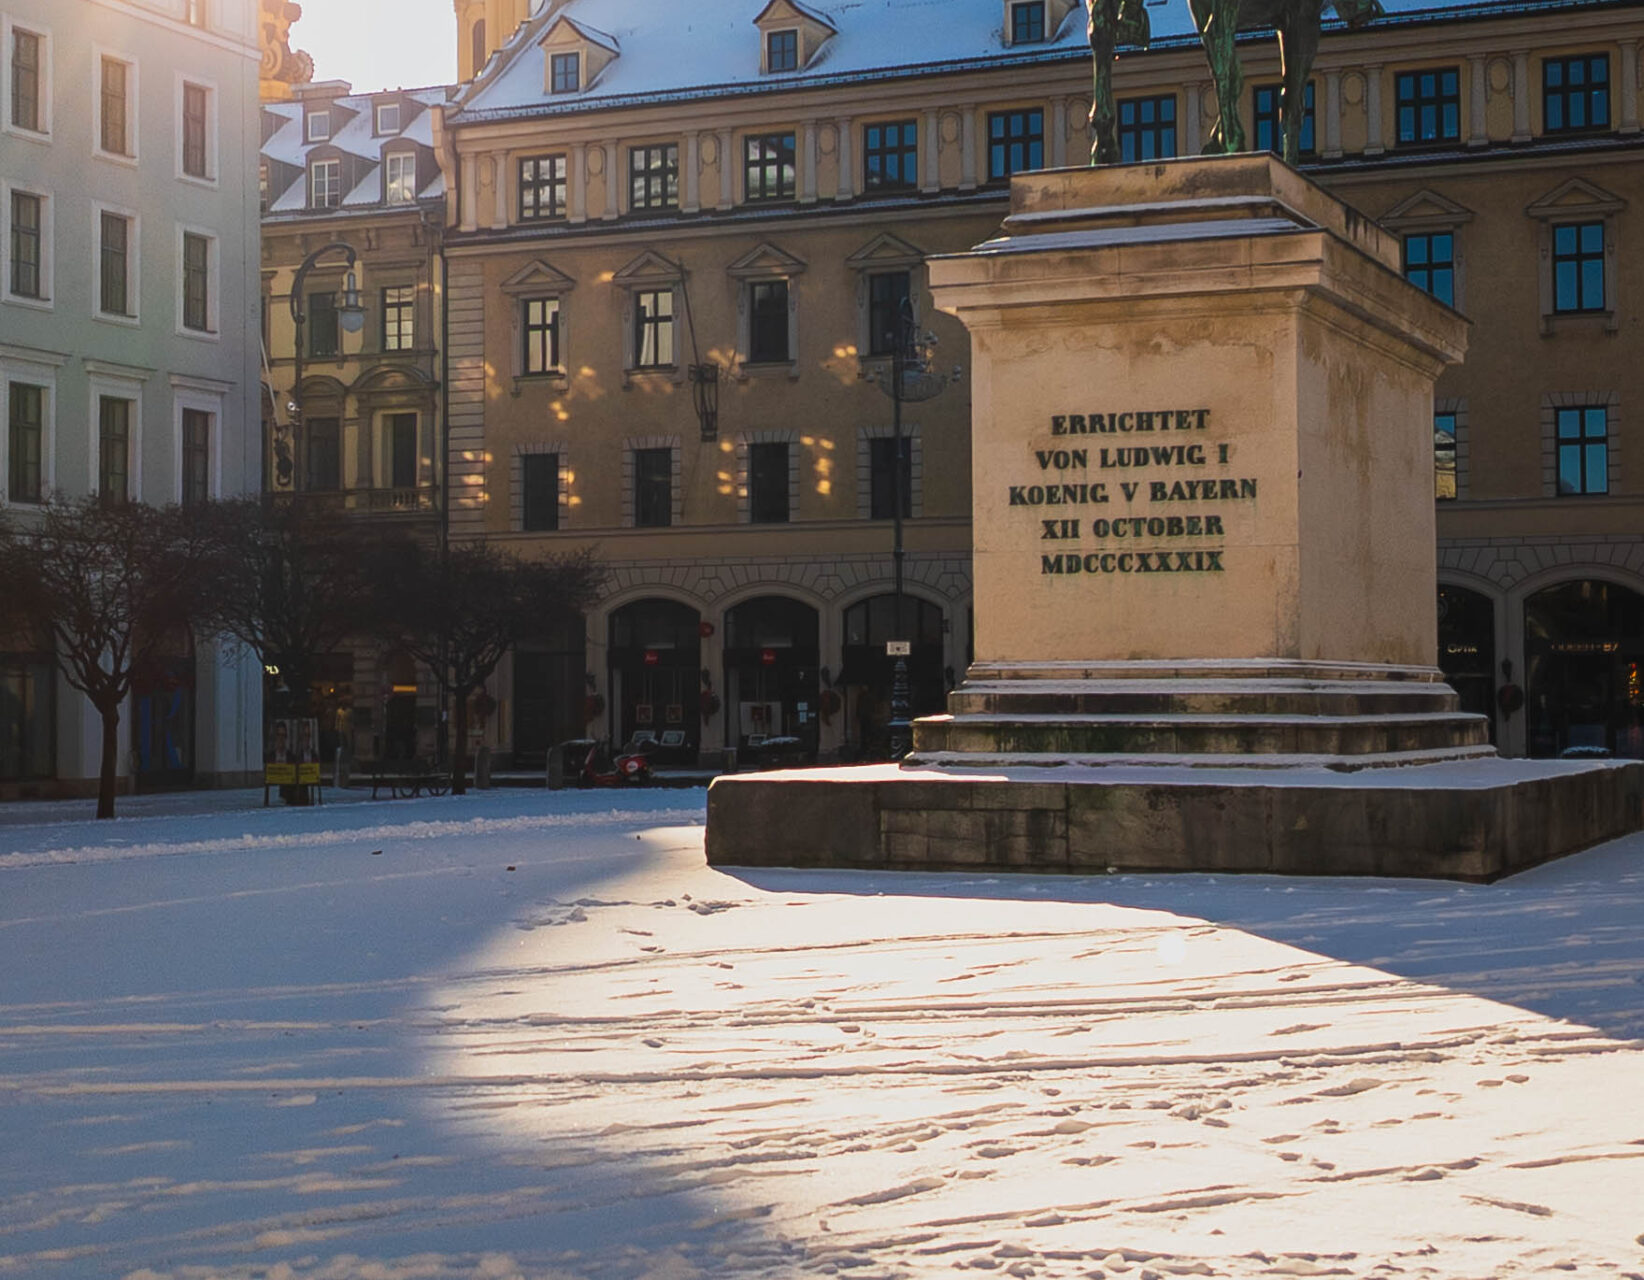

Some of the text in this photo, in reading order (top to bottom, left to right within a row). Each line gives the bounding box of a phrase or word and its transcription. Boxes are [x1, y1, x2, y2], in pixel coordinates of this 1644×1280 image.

[1051, 409, 1210, 435] ERRICHTET
[1035, 444, 1229, 470] VON LUDWIG I
[1009, 478, 1257, 505] KOENIG V BAYERN
[1041, 515, 1225, 539] XII OCTOBER
[1041, 551, 1225, 574] MDCCCXXXIX
